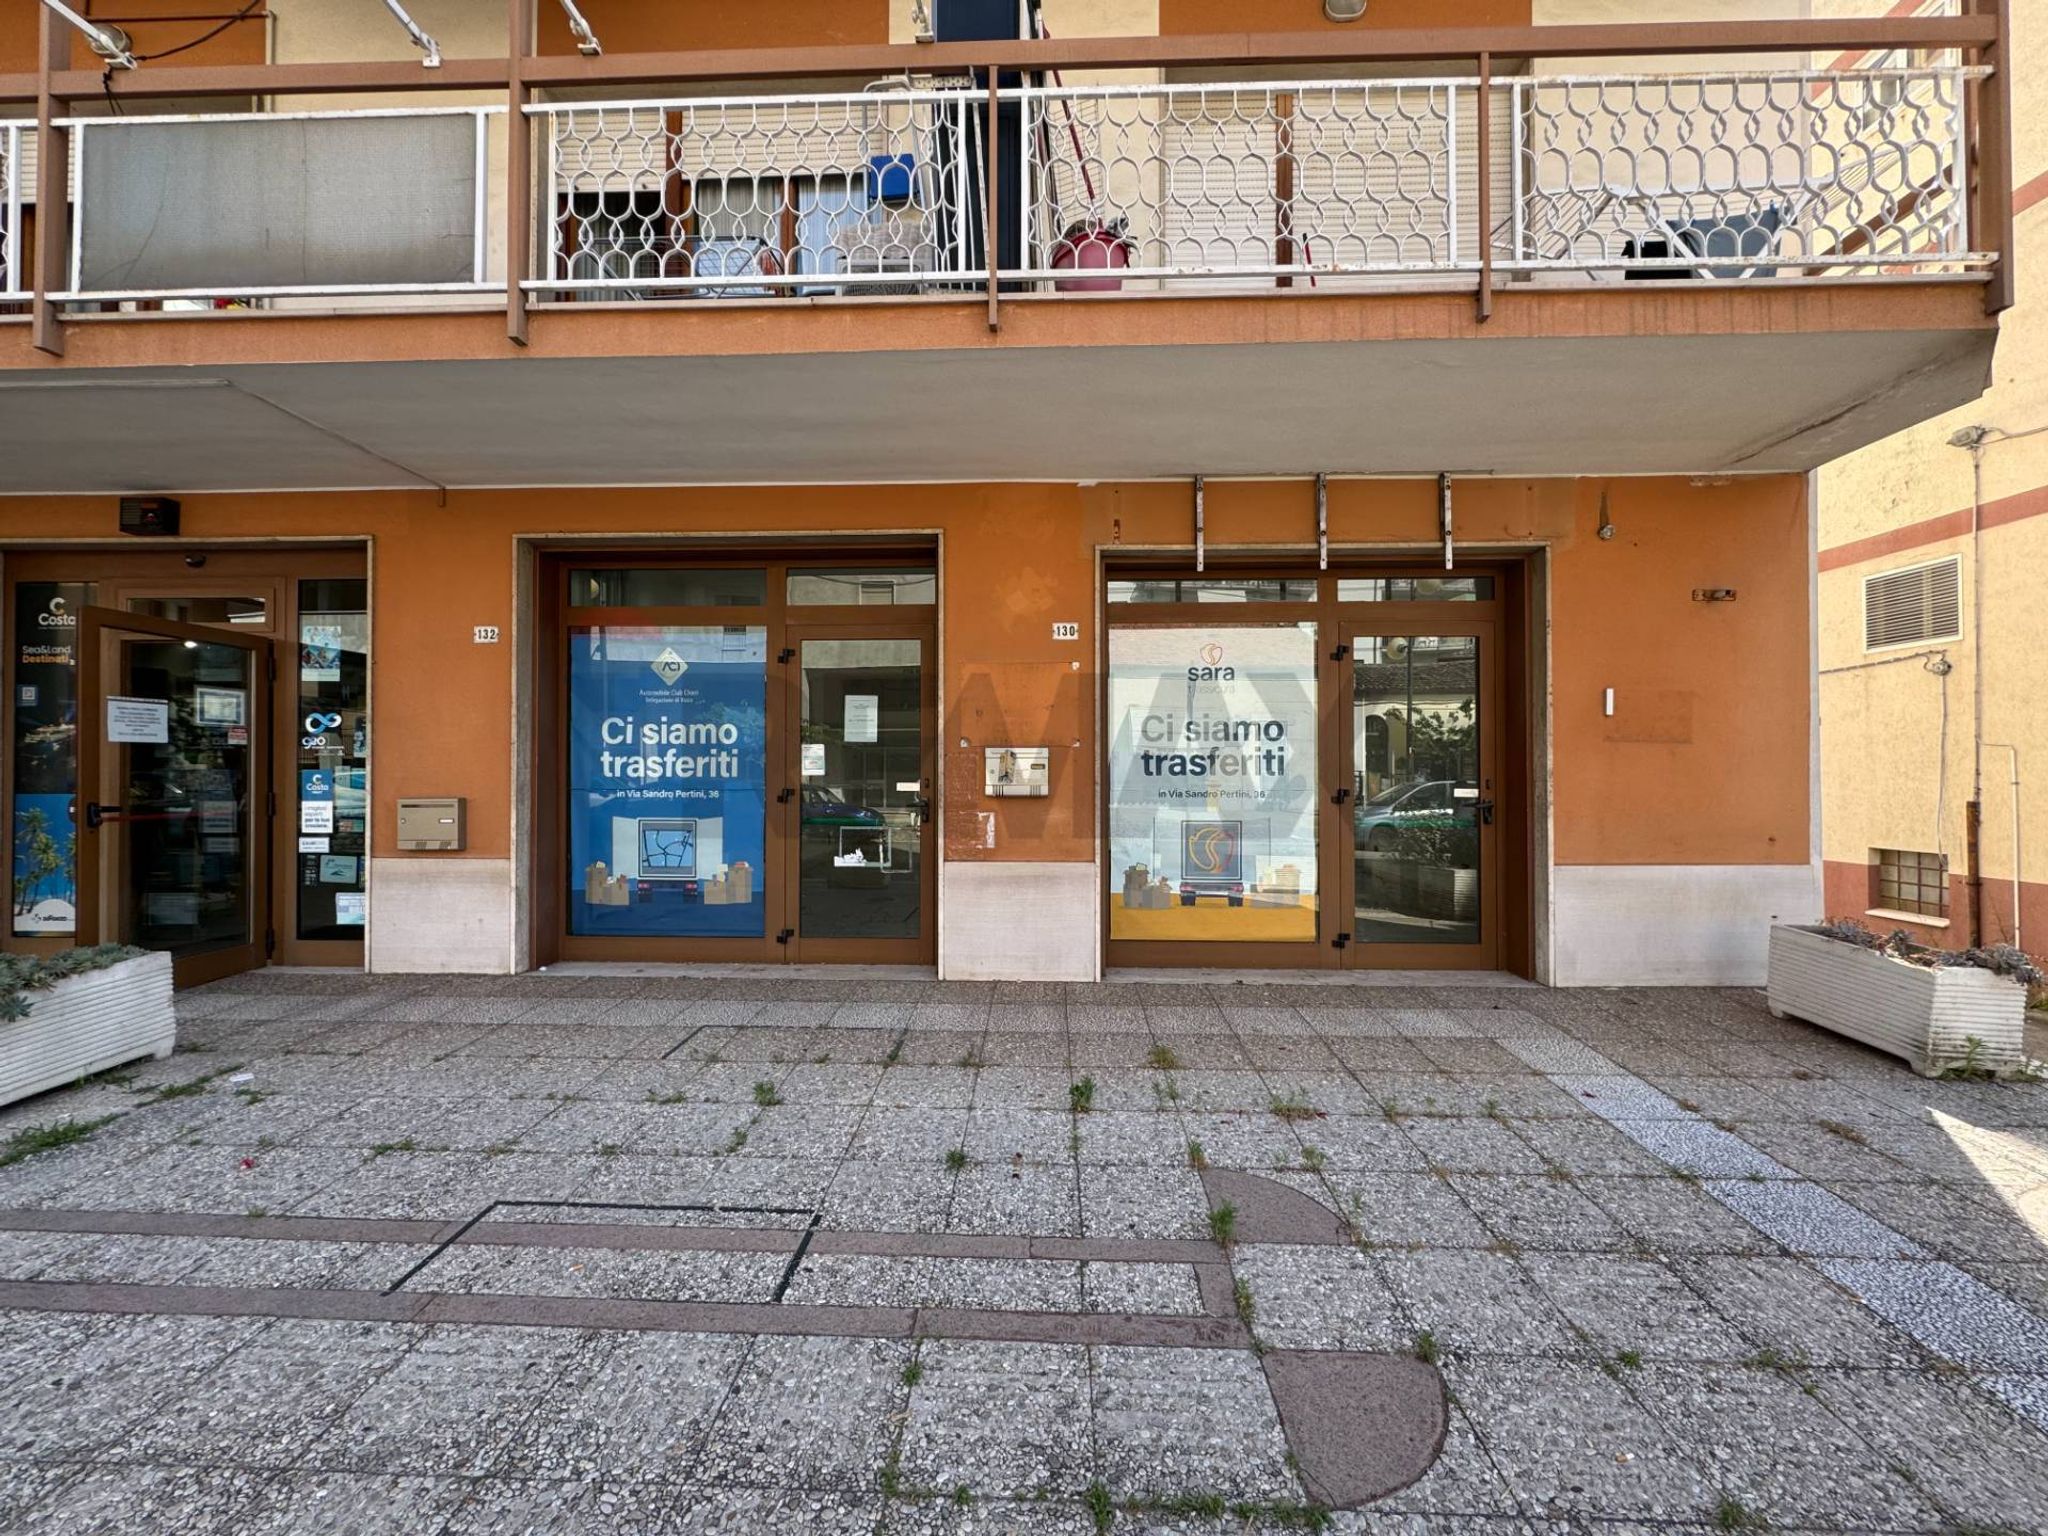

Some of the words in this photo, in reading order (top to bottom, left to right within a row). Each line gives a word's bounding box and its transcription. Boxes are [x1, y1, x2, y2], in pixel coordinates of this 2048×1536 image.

[479, 629, 496, 639] 132
[1056, 625, 1075, 636] 130
[662, 661, 681, 672] ACI
[1187, 666, 1235, 681] sara
[601, 717, 633, 745] Ci
[642, 716, 738, 745] siamo
[1141, 713, 1174, 743] Ci
[1185, 713, 1285, 743] siamo
[600, 749, 738, 778] trasferiti
[1141, 747, 1285, 777] trasferiti
[617, 789, 626, 798] in
[627, 789, 641, 798] Via
[642, 789, 674, 798] Sandro
[675, 789, 707, 800] Pertini,
[1158, 789, 1167, 798] in
[1168, 789, 1183, 798] Via
[1185, 790, 1218, 798] Sandro
